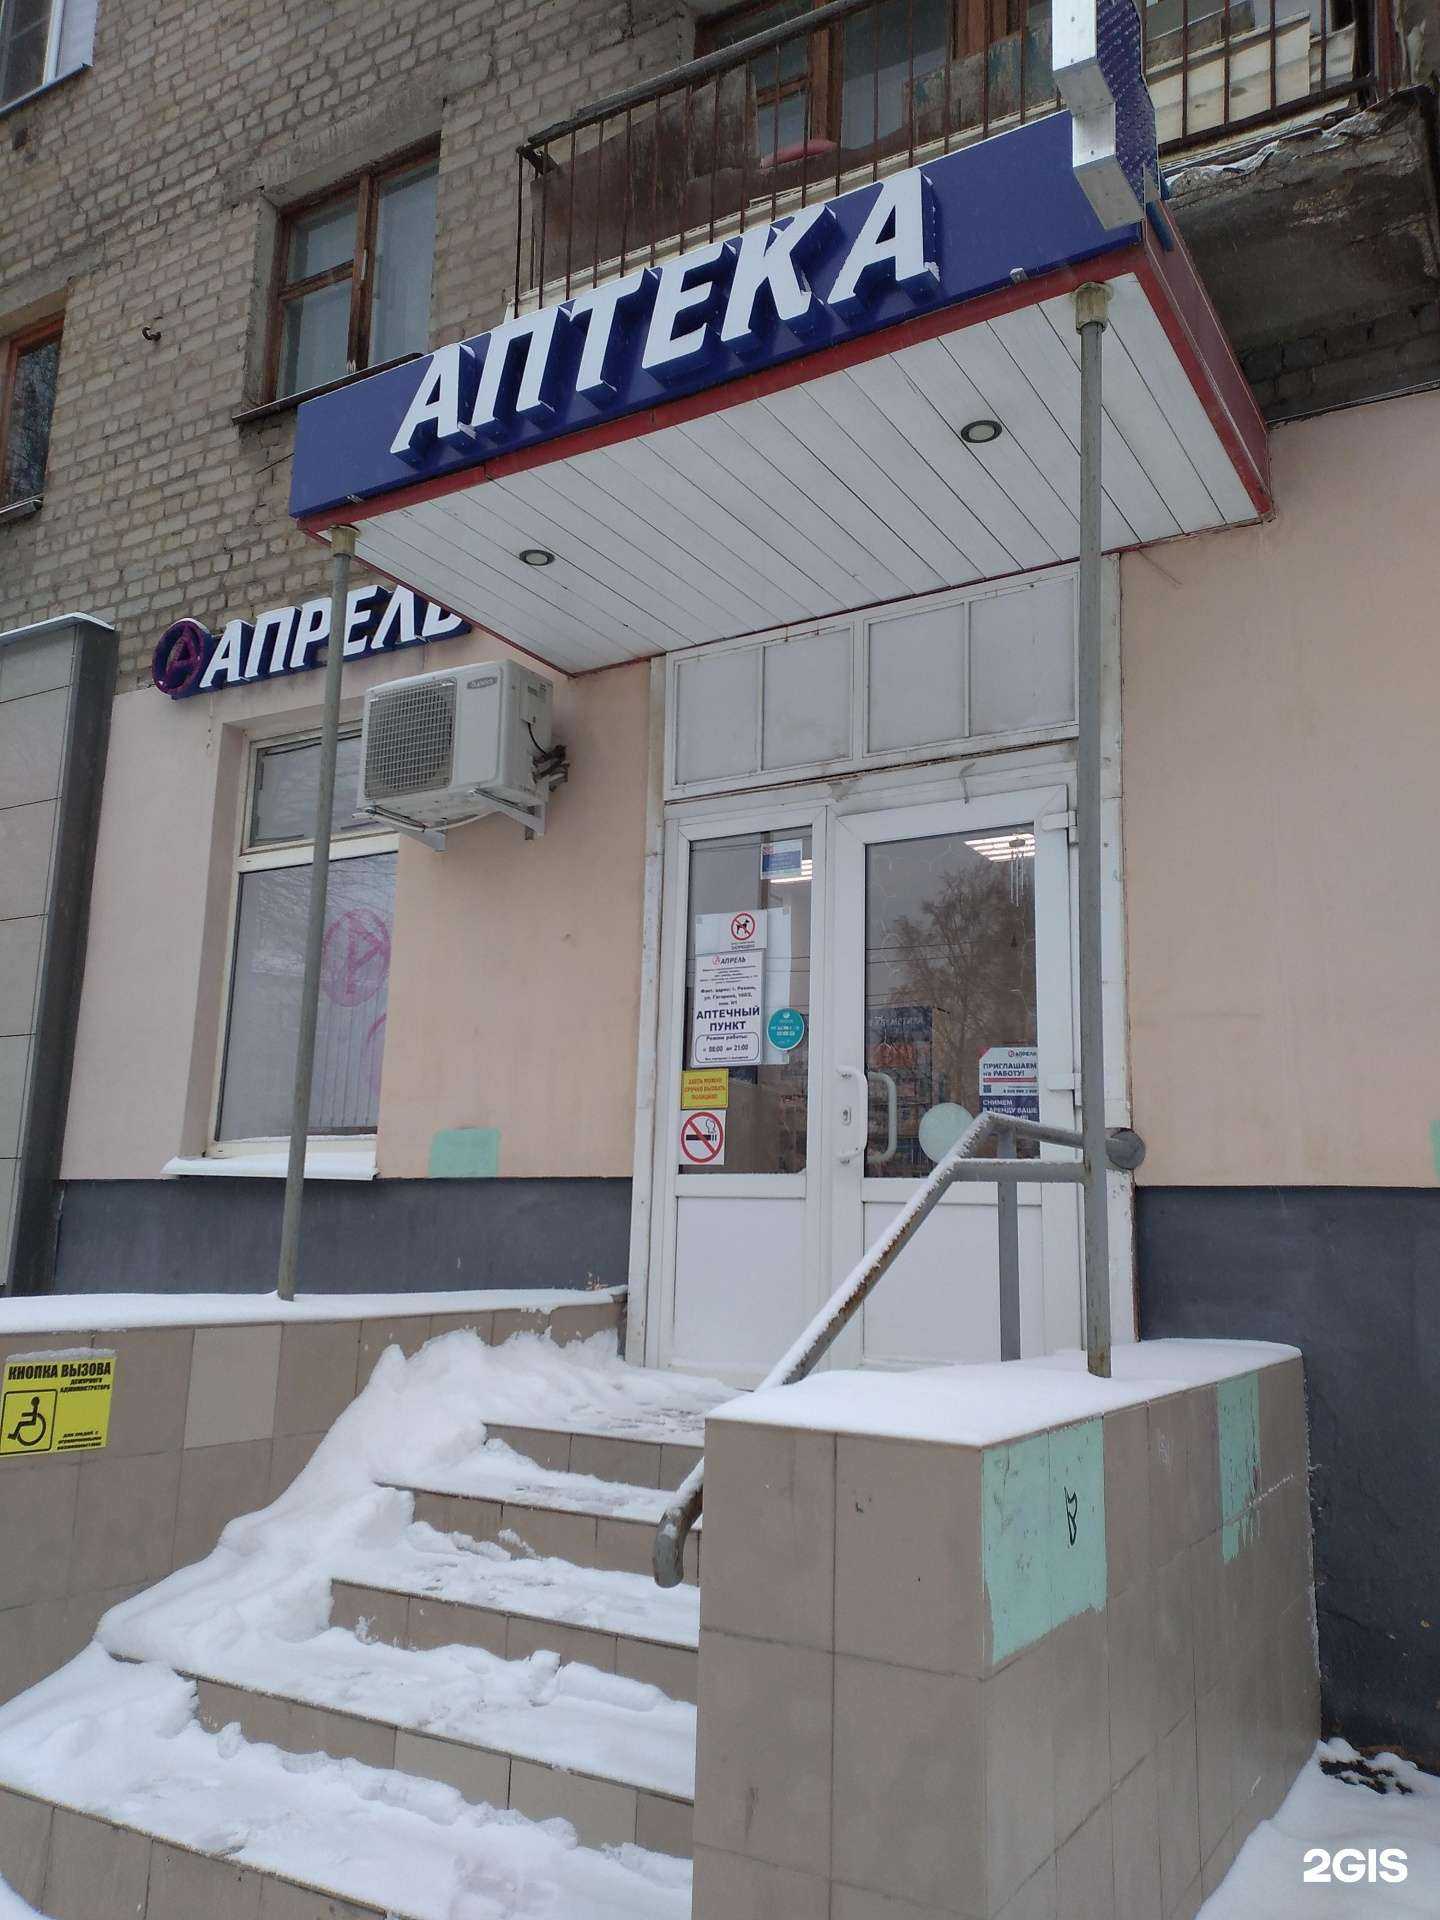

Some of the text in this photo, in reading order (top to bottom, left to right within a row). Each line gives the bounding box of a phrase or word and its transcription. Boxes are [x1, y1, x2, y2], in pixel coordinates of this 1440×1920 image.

[390, 167, 932, 455] АПТЕКА
[720, 956, 746, 964] АПРЕЛЬ
[696, 1005, 760, 1020] АПТЕЧНЫЙ
[710, 1021, 746, 1031] ПУНКТ
[8, 1362, 111, 1380] КНОПКА ВЫЗОВА
